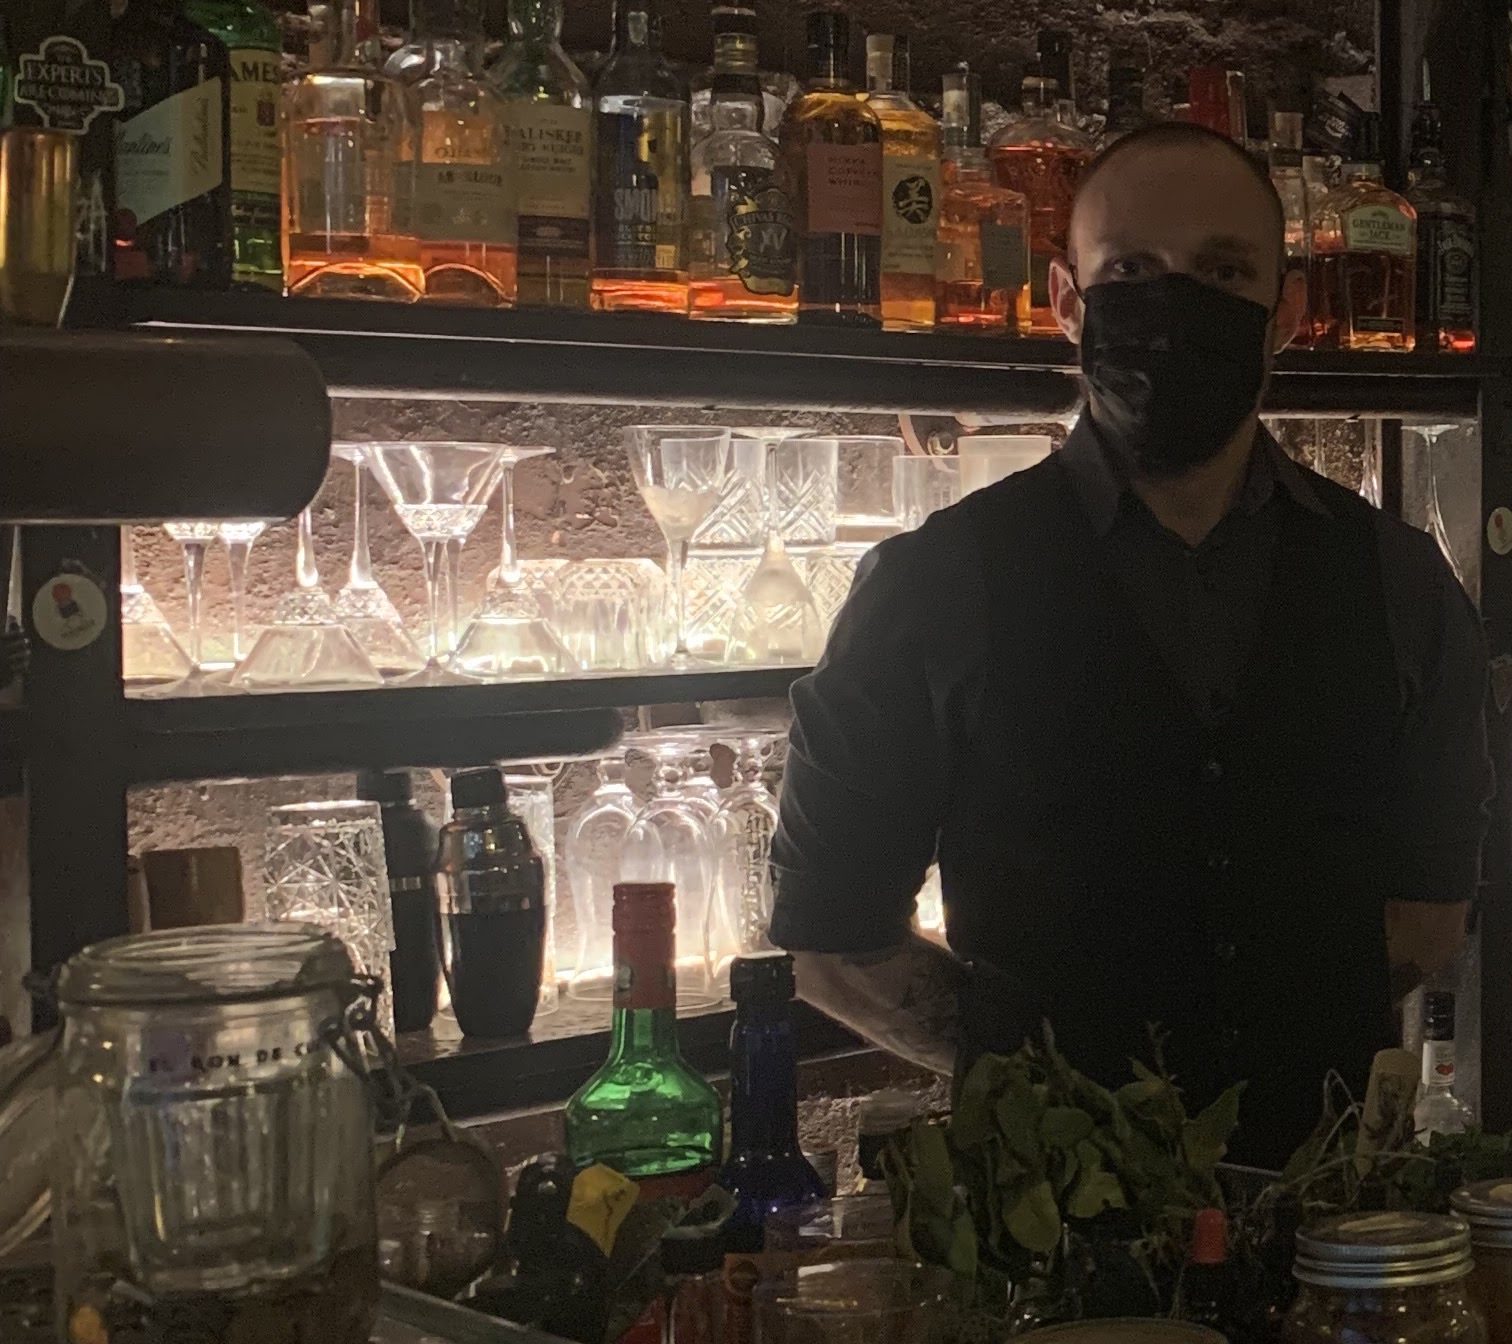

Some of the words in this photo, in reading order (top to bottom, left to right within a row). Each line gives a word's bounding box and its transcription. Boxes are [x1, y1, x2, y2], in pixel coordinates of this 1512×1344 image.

[229, 61, 281, 84] AMES
[1352, 218, 1406, 232] GENTLEMAN
[1369, 229, 1390, 240] JACK
